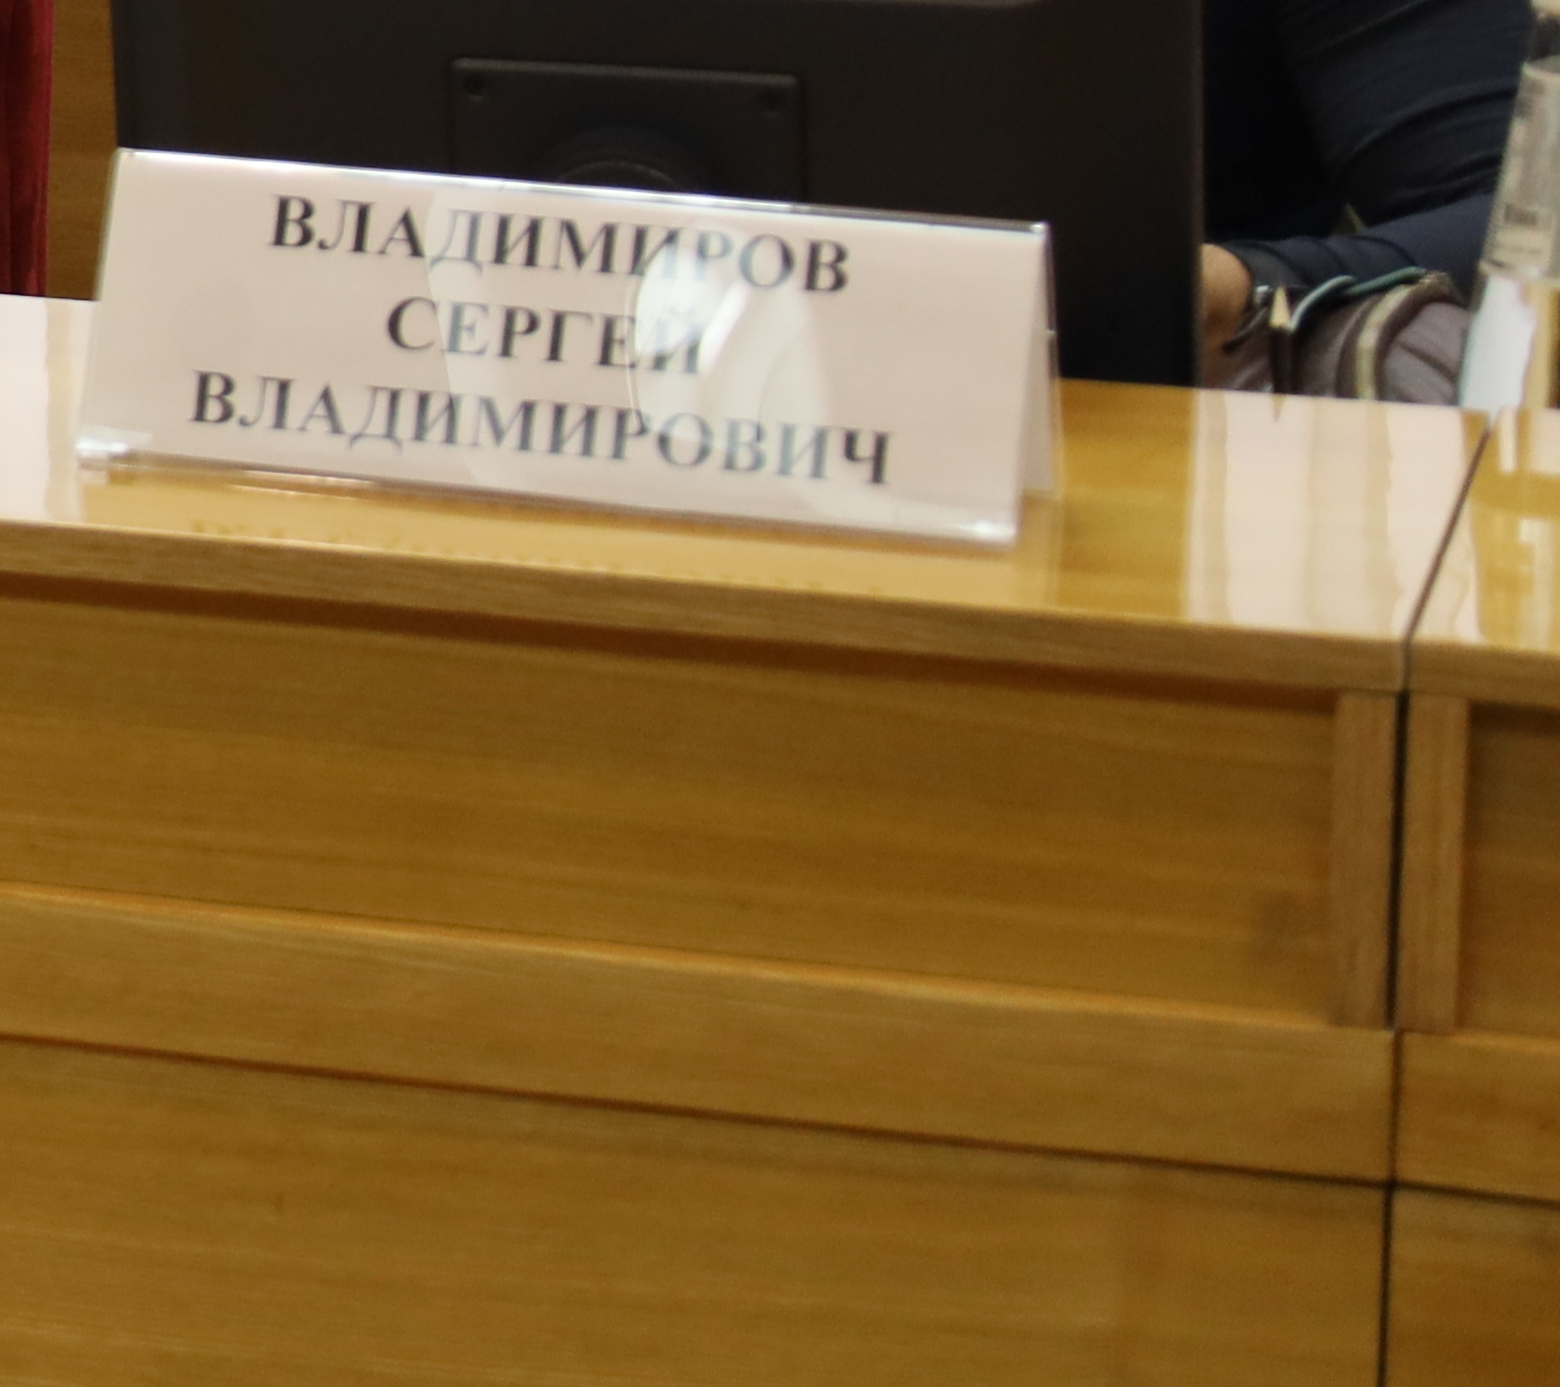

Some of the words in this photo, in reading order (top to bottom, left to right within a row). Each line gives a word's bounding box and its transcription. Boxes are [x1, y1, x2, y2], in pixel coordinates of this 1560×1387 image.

[268, 195, 850, 293] ВЛАДИМИРОВ
[387, 297, 704, 375] СЕРГЕЙ
[190, 372, 892, 486] ВЛАДИМИРОВИЧ
